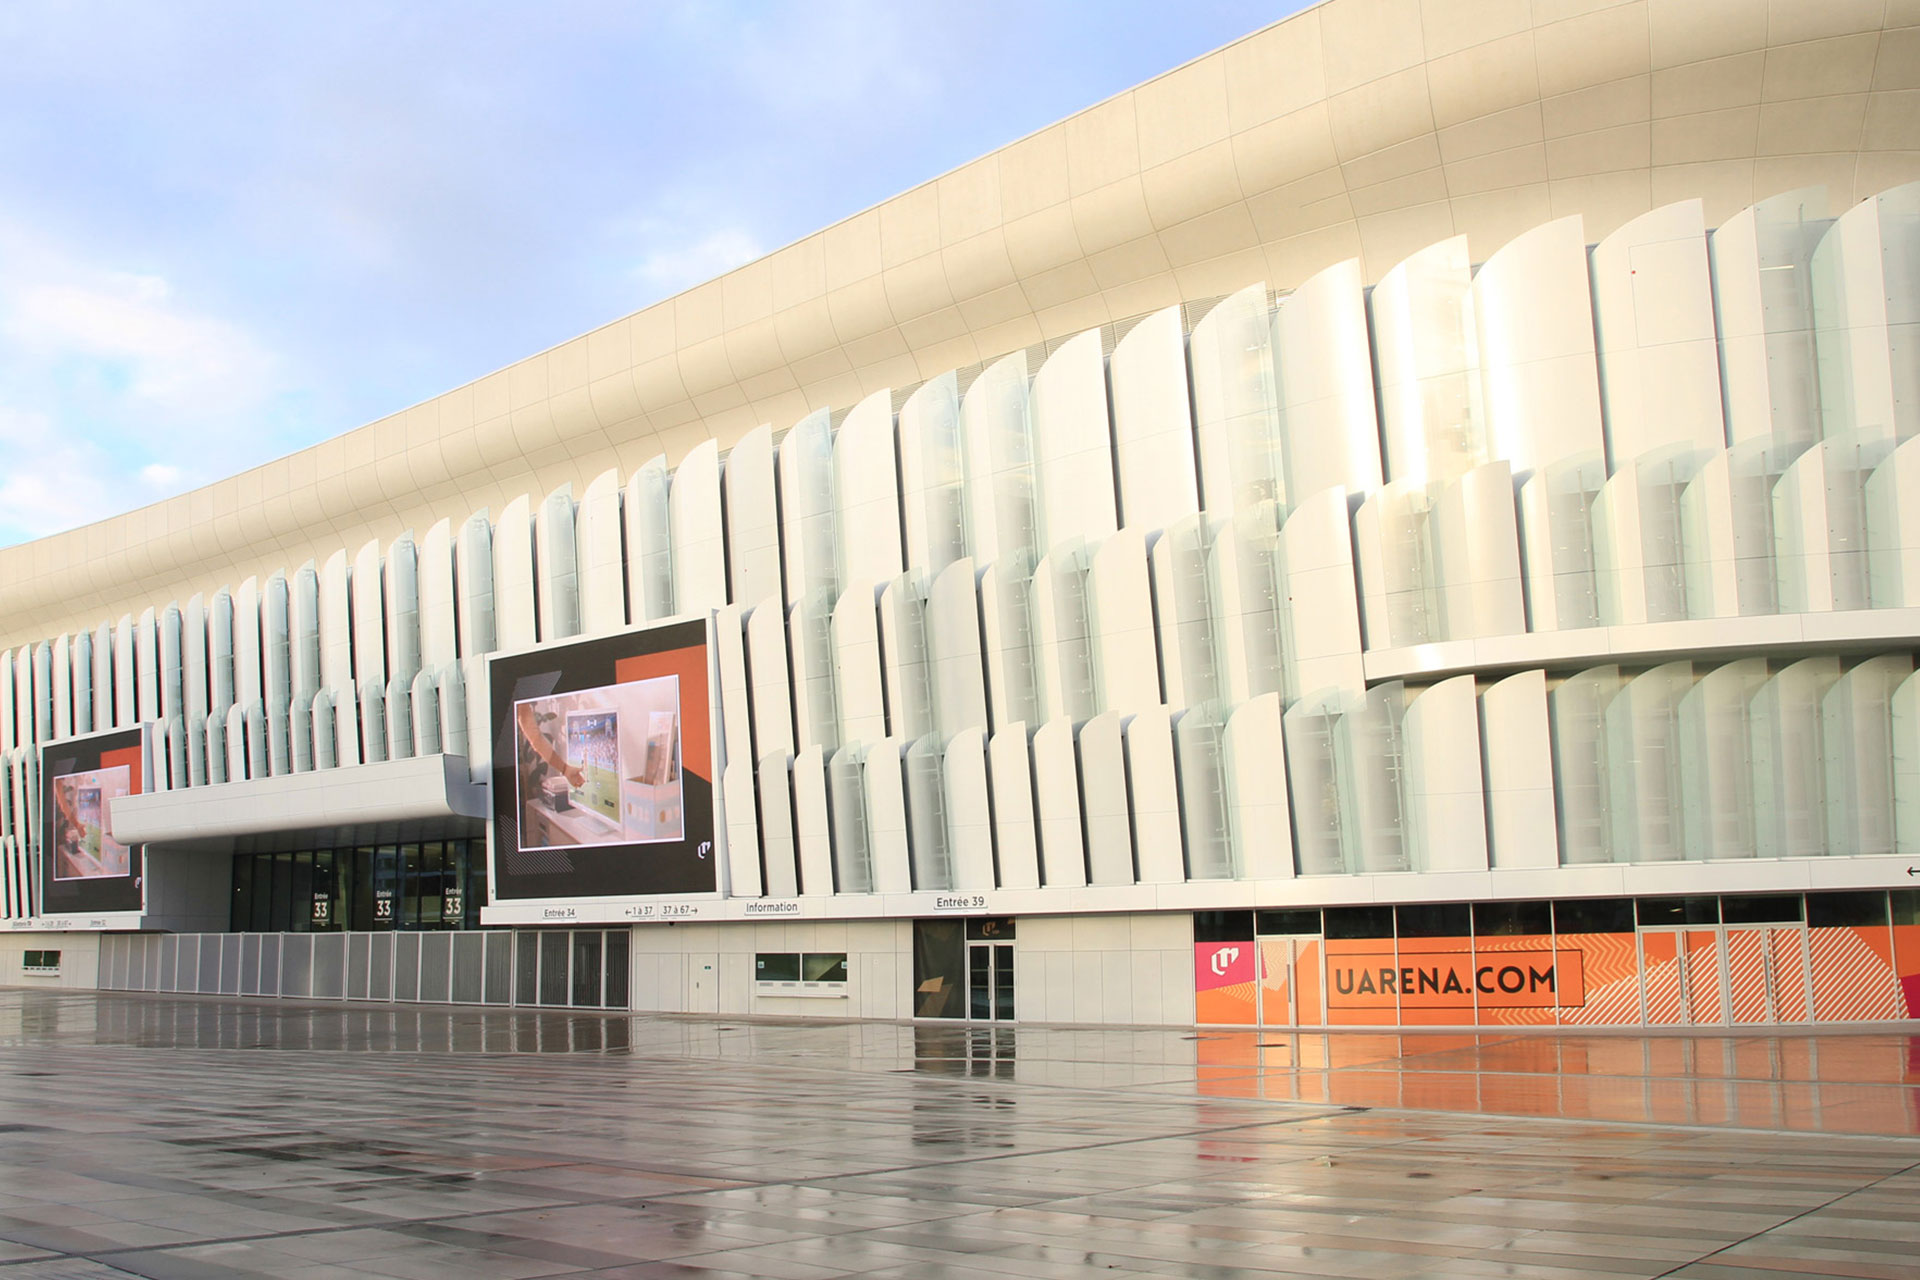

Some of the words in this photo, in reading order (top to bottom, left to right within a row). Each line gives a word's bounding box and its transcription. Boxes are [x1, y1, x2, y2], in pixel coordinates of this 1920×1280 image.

[446, 898, 461, 914] 33
[746, 902, 798, 912] Information
[936, 897, 969, 907] Entrée
[972, 896, 985, 906] 39
[314, 902, 328, 917] 33
[376, 900, 391, 916] 33
[544, 909, 565, 917] Entrée
[567, 908, 576, 917] 34
[633, 907, 637, 915] 1
[644, 906, 654, 915] 37
[663, 905, 673, 915] 37
[680, 905, 690, 914] 67
[1335, 965, 1556, 995] UARENA.COM
